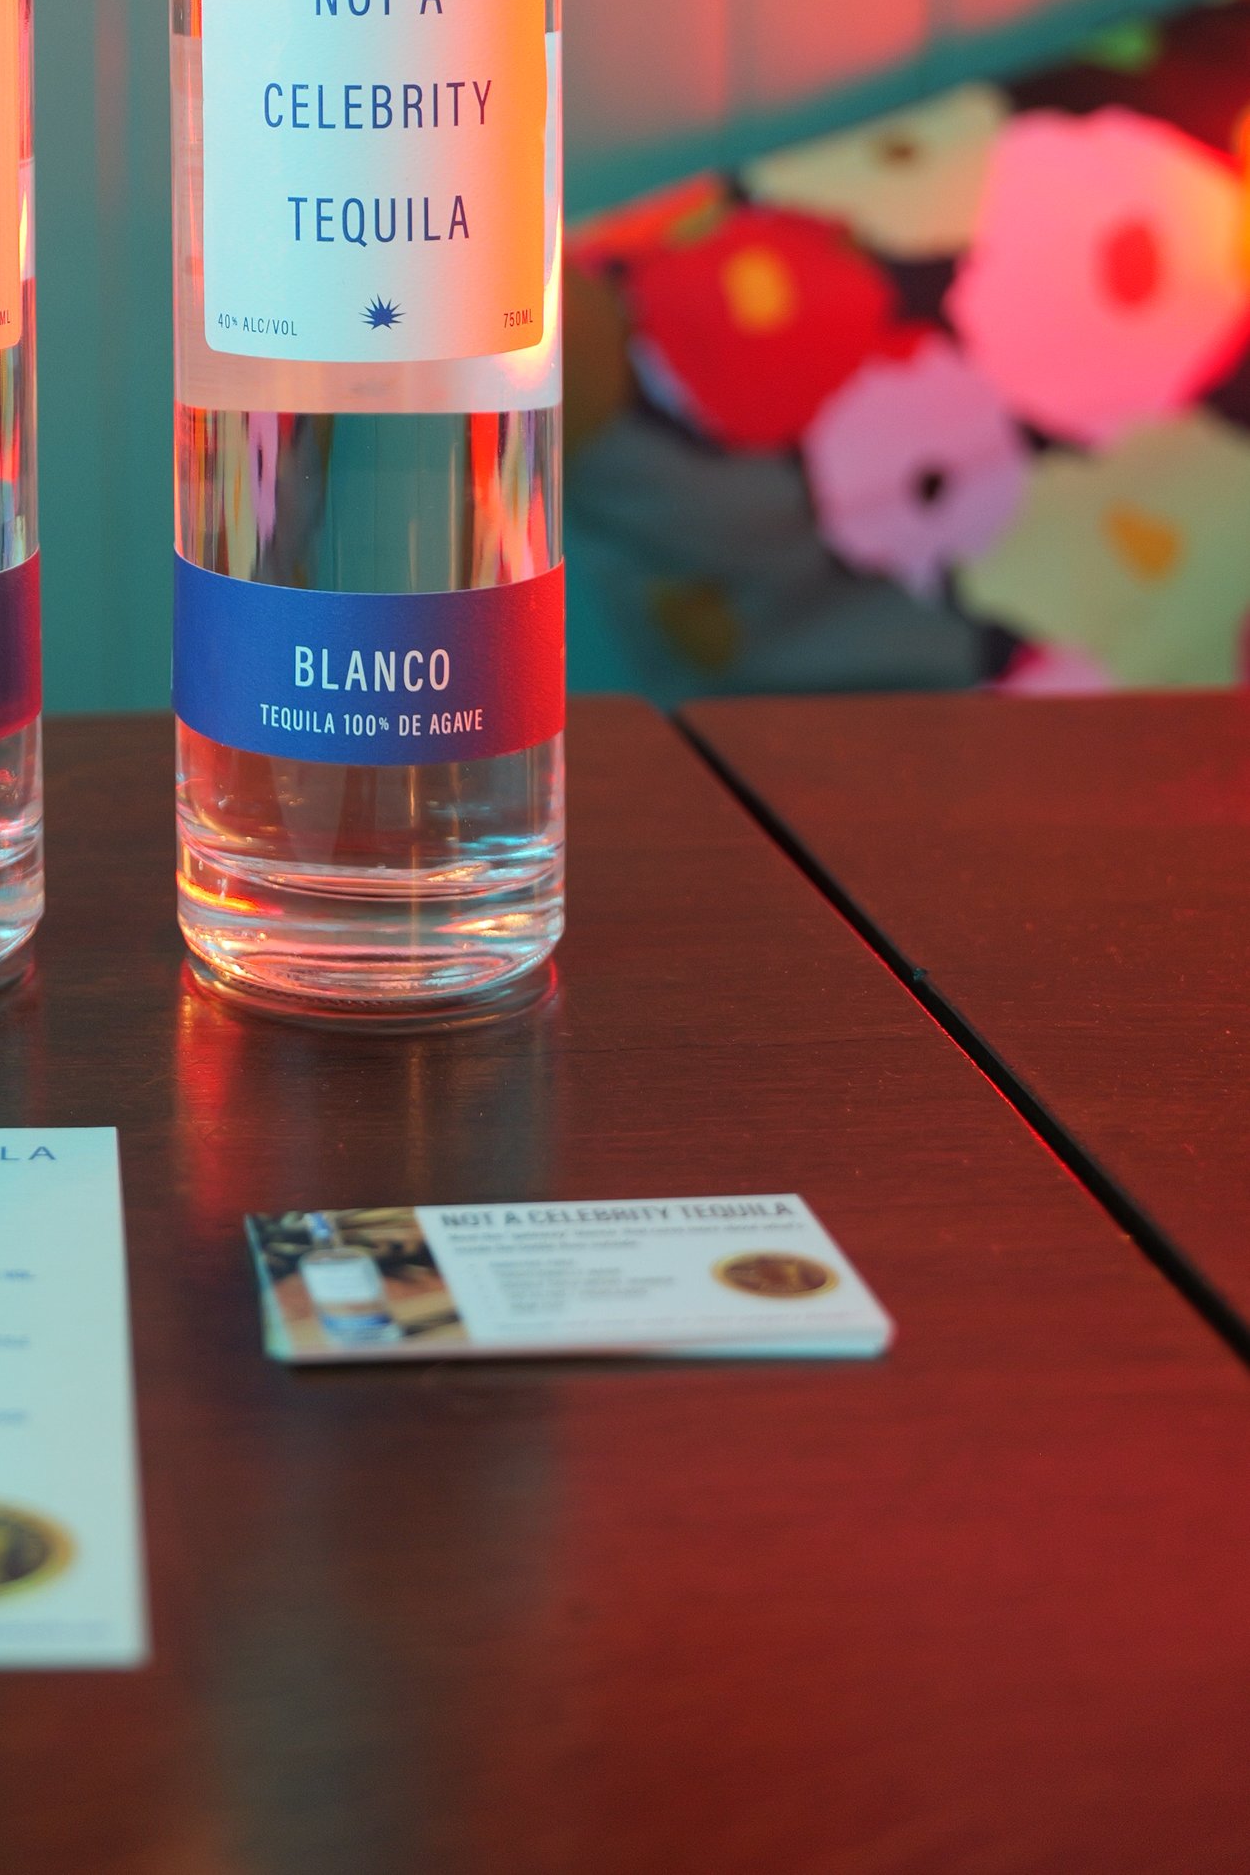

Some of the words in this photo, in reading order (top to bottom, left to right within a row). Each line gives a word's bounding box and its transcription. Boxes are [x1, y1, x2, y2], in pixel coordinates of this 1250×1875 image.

[264, 80, 493, 130] CELEBRITY
[288, 195, 470, 248] TEQUILA
[217, 313, 238, 331] 40%
[242, 316, 298, 337] ALC/VOL
[503, 308, 534, 329] 750ML
[295, 646, 452, 692] BLANCO
[260, 703, 335, 736] TEQUILA
[343, 711, 389, 738] 100%
[398, 711, 422, 737] DE
[429, 708, 484, 735] AGAVE
[442, 1208, 495, 1228] NOT
[504, 1208, 522, 1226] A
[528, 1204, 670, 1225] CELEBRITY
[675, 1200, 794, 1220] TEQUILA
